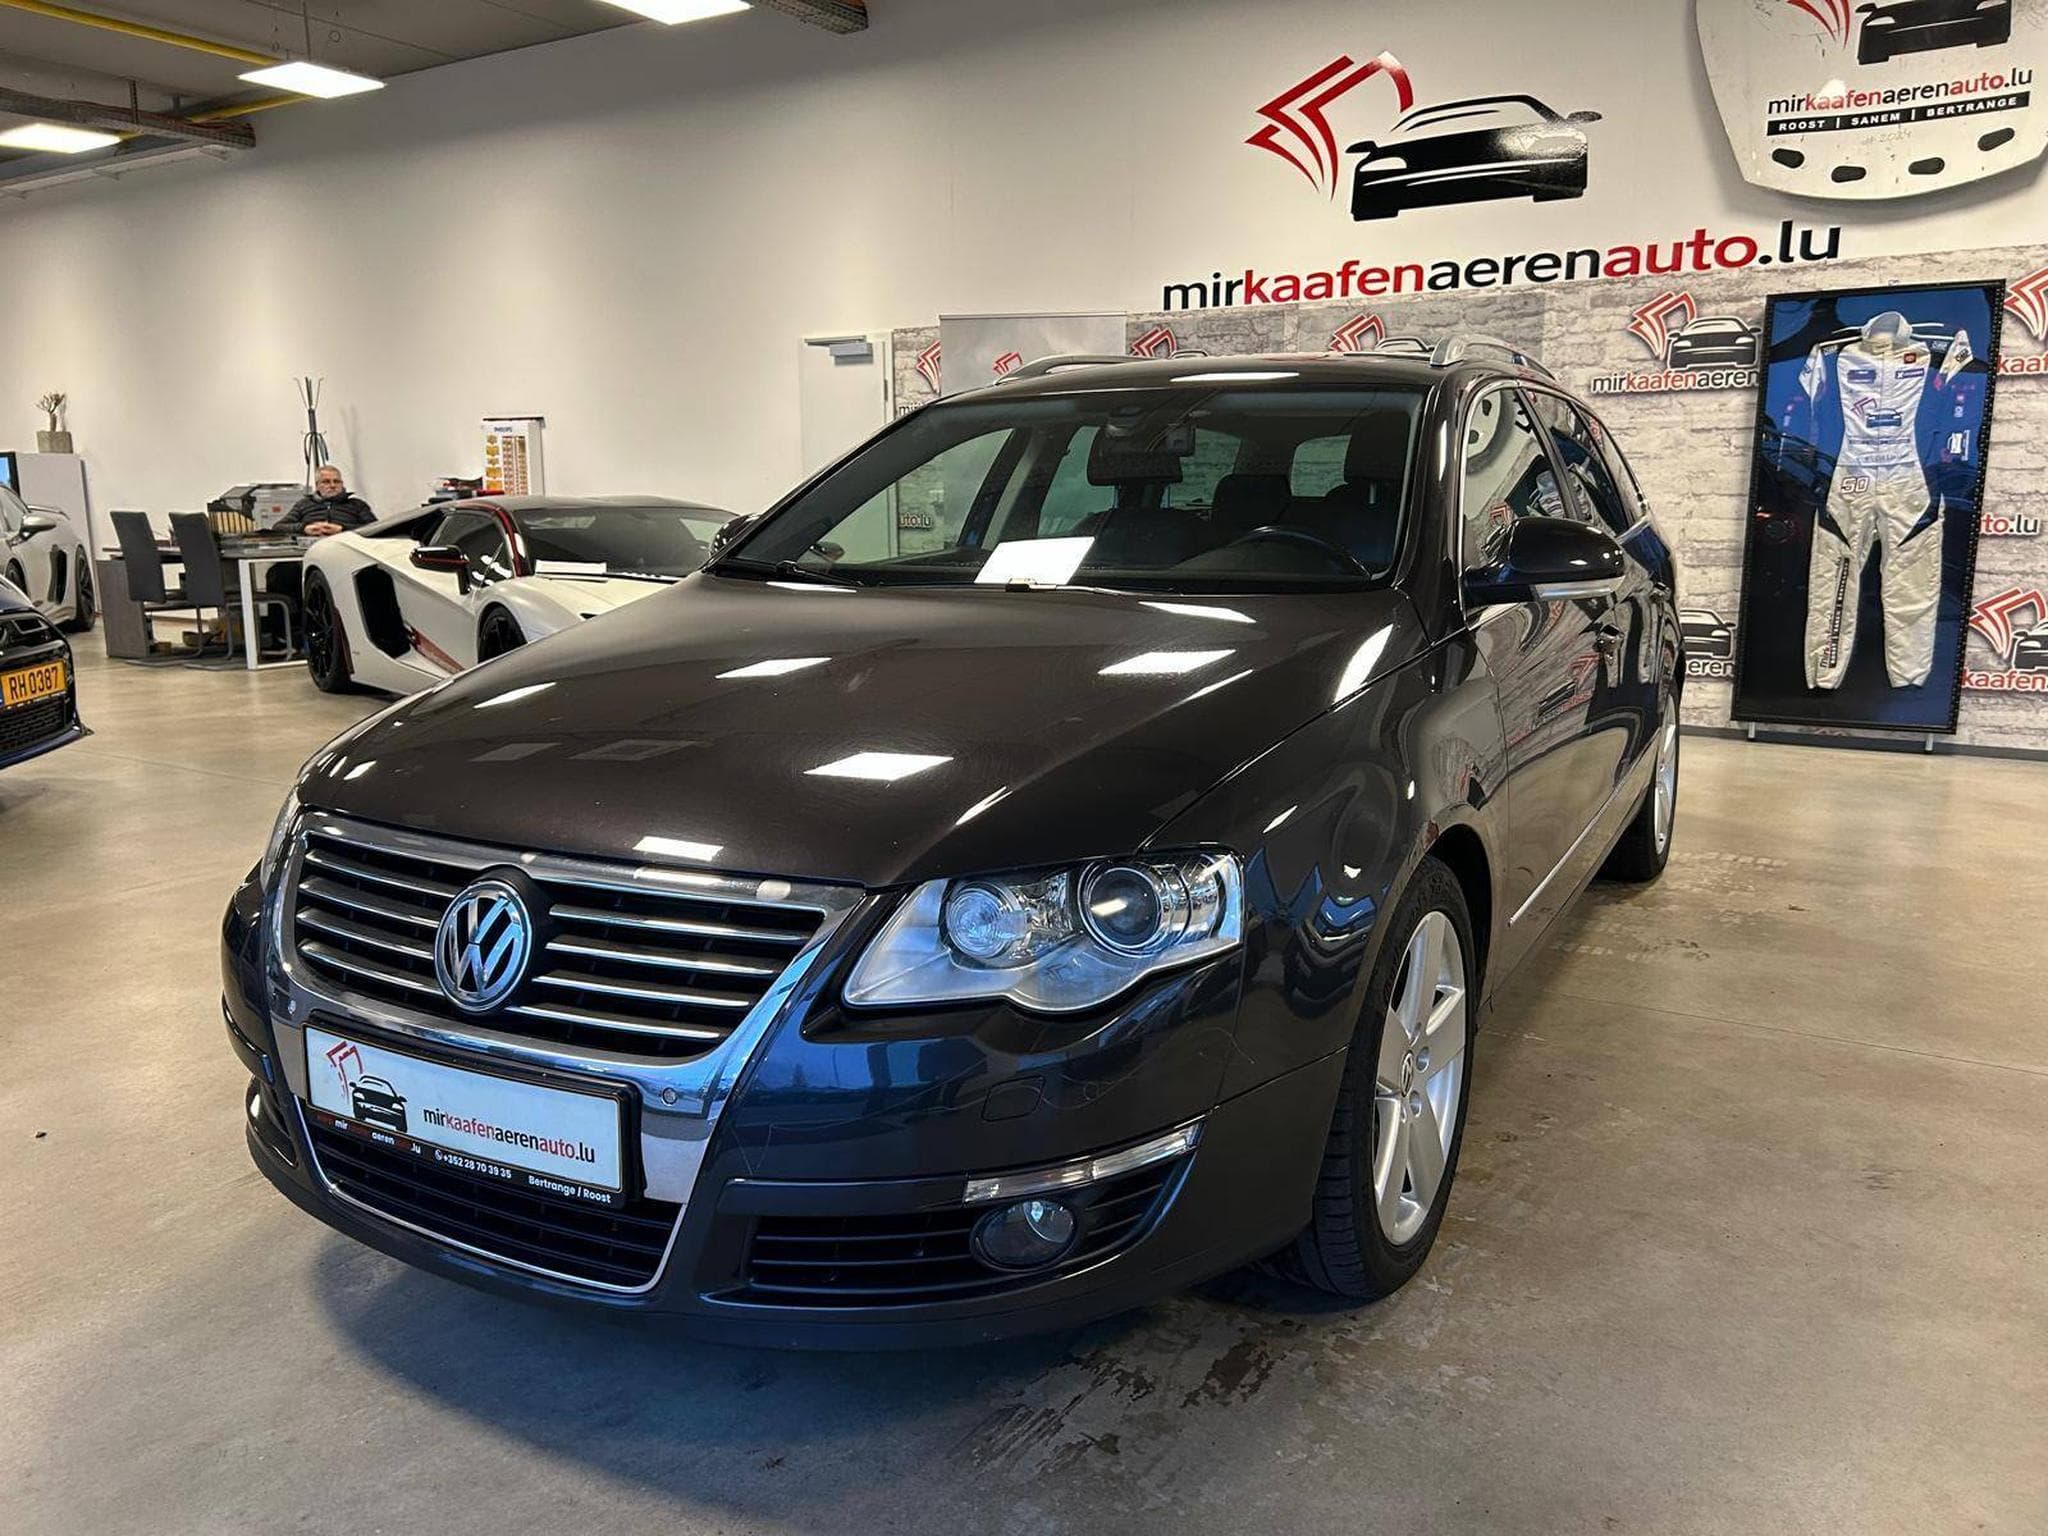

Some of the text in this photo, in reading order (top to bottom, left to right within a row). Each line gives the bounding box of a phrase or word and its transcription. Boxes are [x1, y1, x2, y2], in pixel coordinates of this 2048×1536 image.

[1767, 68, 2033, 114] mirkaafenaerenauto.lu
[1778, 120, 1826, 132] ROOST
[1851, 112, 1901, 126] SANEM
[1926, 96, 2018, 117] BERTRANGE
[1163, 220, 1842, 311] mirkaafenaerenauto.lu
[9, 666, 59, 699] RH 0387
[424, 1105, 595, 1163] mirkaafenaerenauto.lu
[528, 1175, 576, 1197] Bertrange
[583, 1190, 611, 1204] Roost
